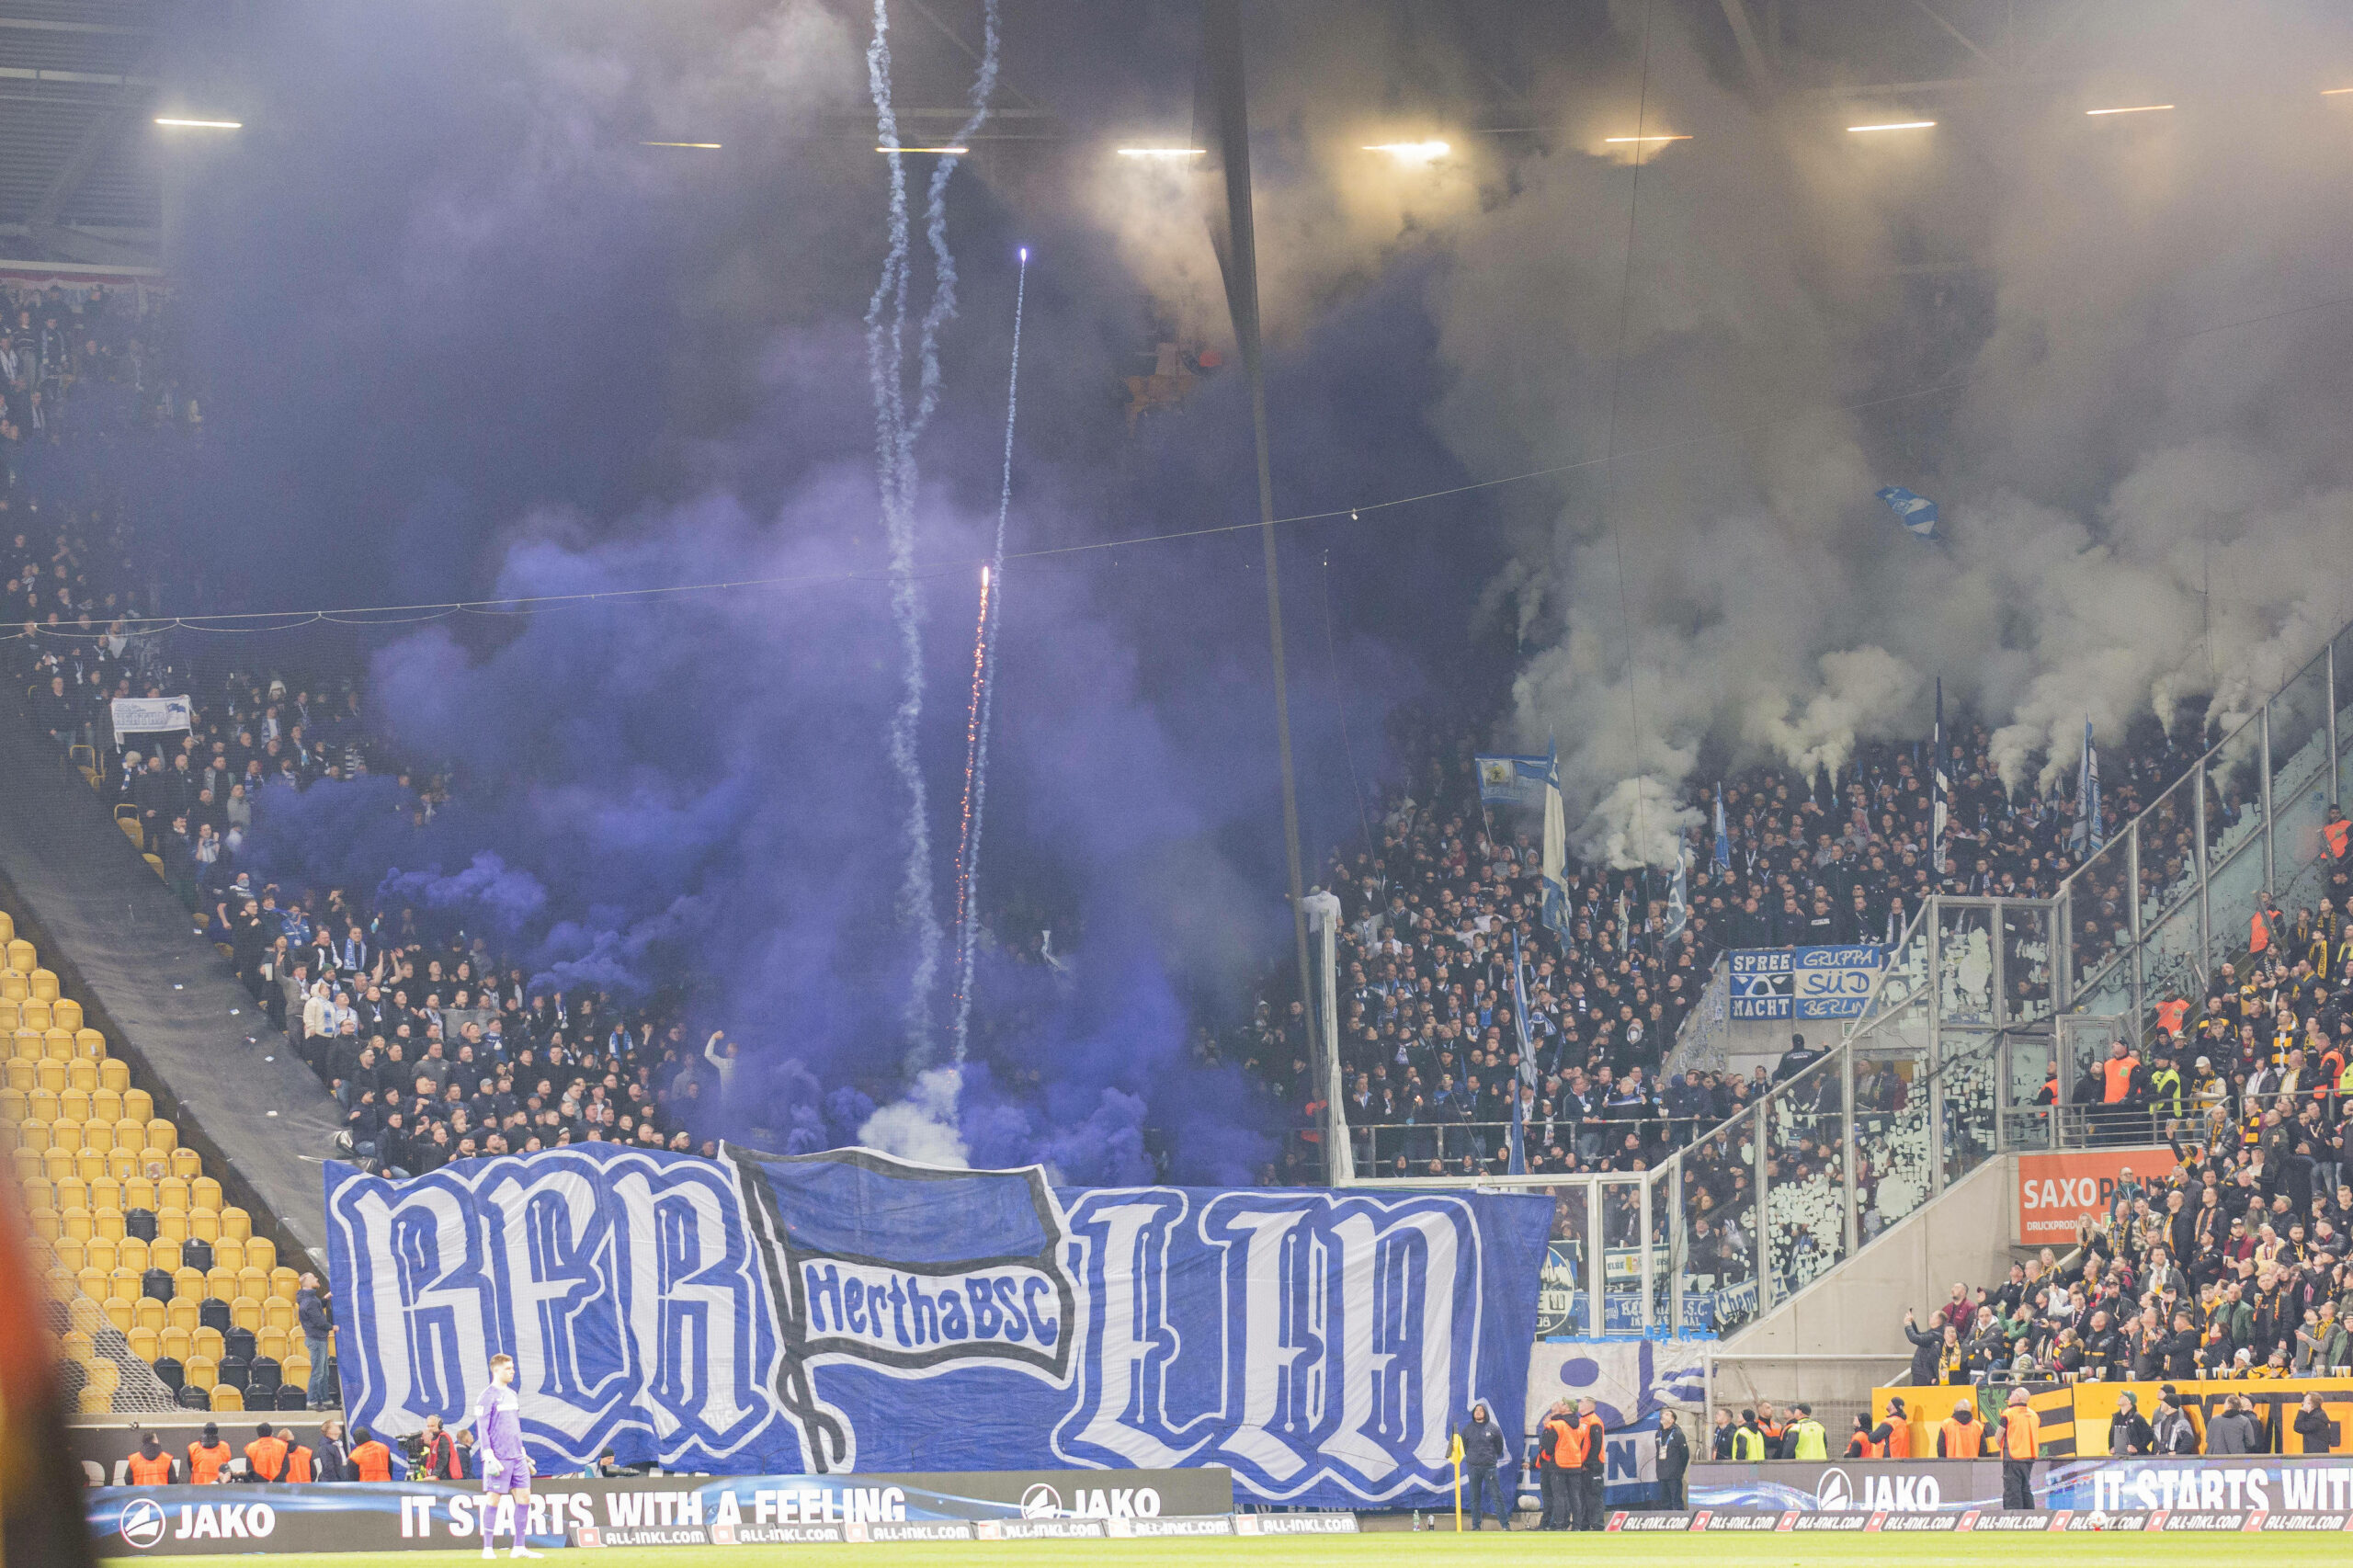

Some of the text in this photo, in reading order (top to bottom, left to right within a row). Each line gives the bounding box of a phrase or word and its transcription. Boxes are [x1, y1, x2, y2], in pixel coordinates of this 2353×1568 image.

[1733, 953, 1790, 971] SPREE
[1803, 949, 1872, 966] GRUPPA
[1802, 971, 1870, 995] SÜD
[1733, 998, 1790, 1017] MACHT
[1803, 999, 1869, 1017] BERLIN
[1074, 1487, 1162, 1517] JAKO
[1859, 1474, 1940, 1511] JAKO
[2094, 1468, 2353, 1510] IT STARTS WIT
[175, 1503, 276, 1540] JAKO
[401, 1486, 906, 1539] IT STARTS WITH A FEELING
